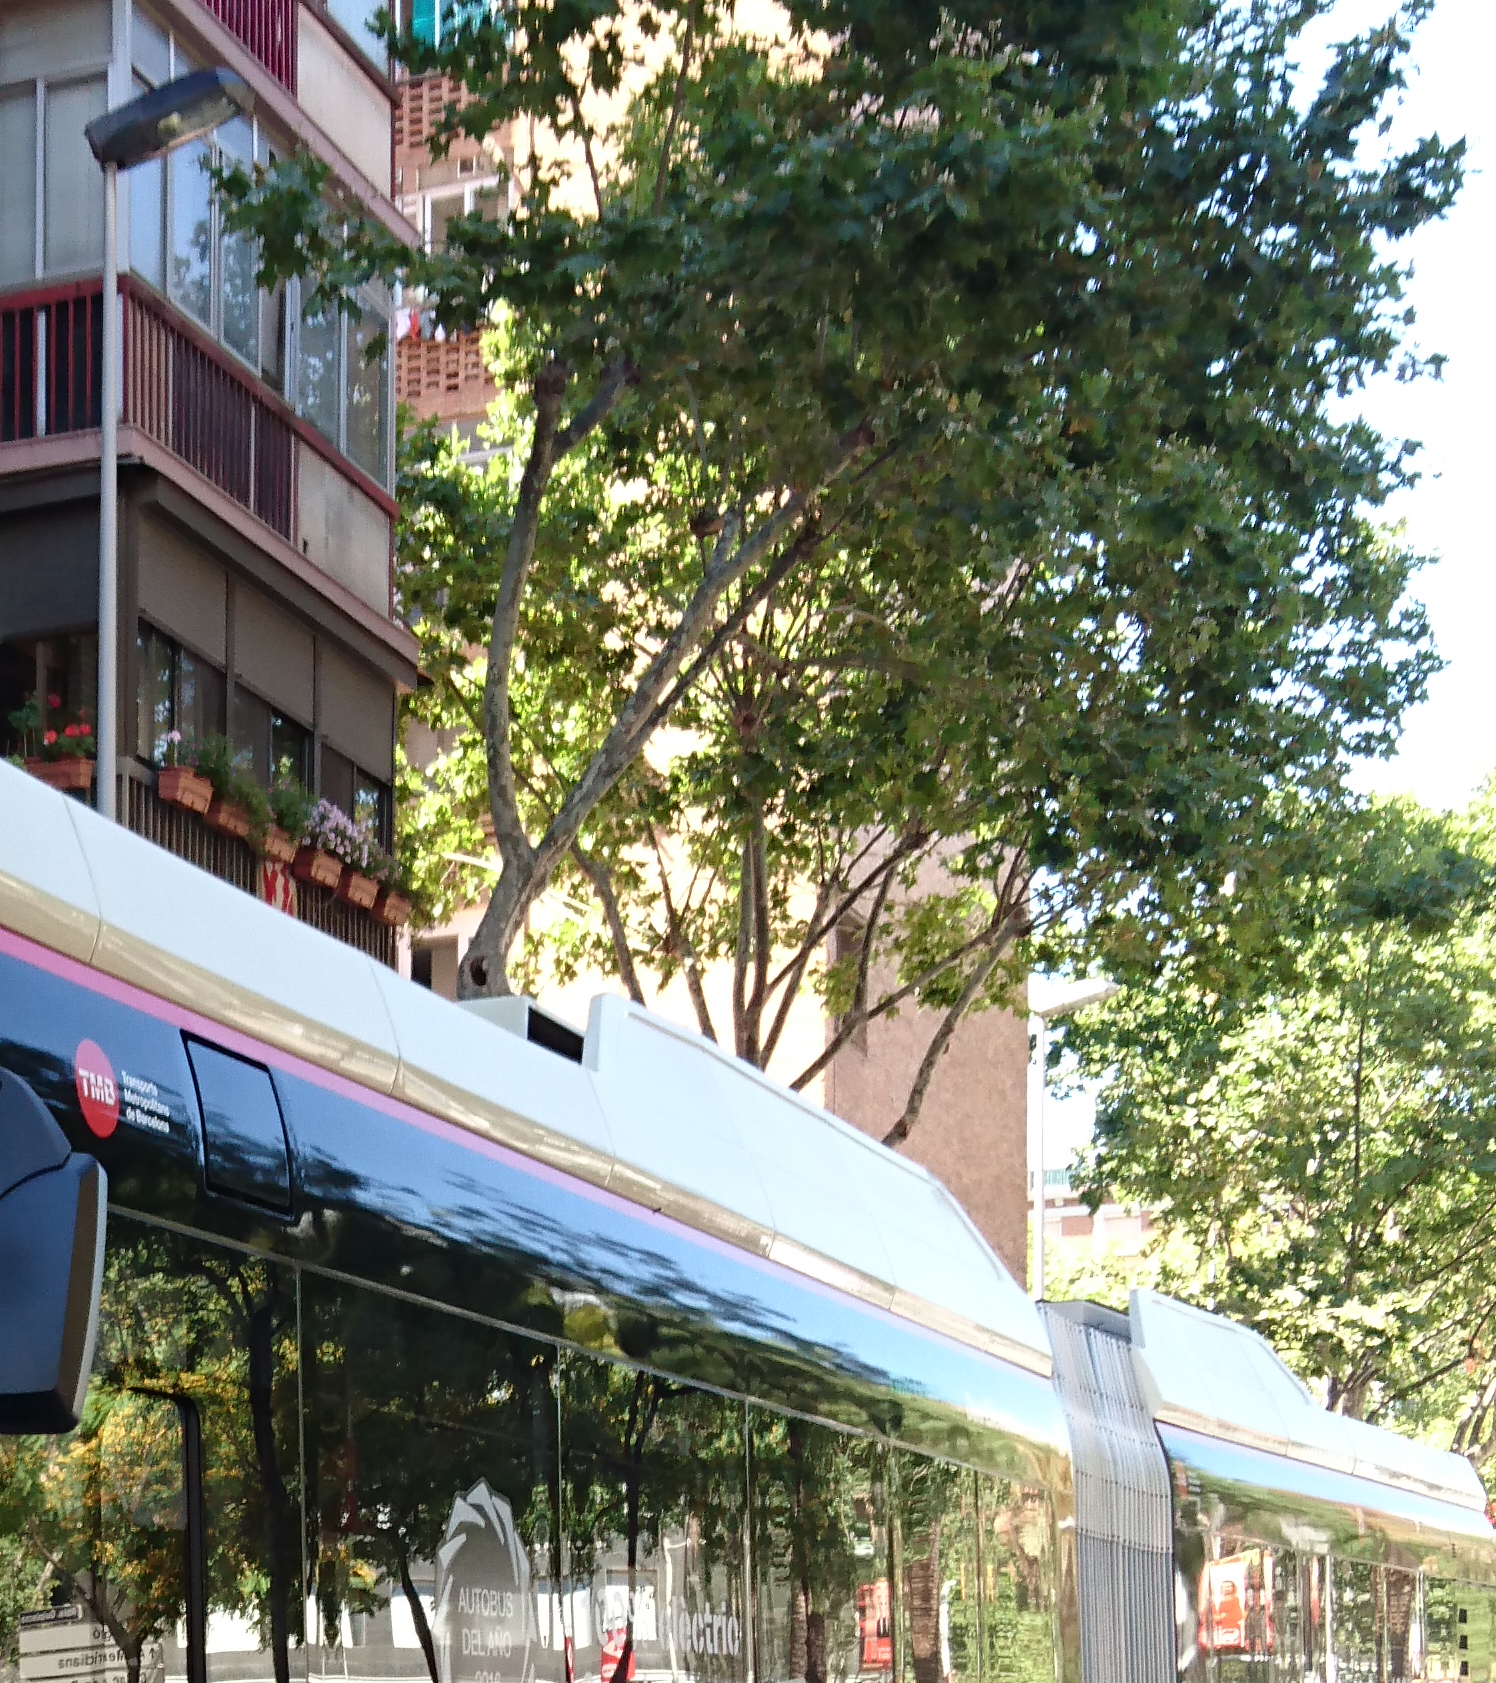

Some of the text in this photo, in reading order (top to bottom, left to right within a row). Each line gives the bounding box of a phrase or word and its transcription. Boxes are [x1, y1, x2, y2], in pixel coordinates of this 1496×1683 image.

[78, 1068, 115, 1106] TMB
[136, 1108, 170, 1134] Barcelona
[458, 1586, 513, 1618] AUTOBUS
[462, 1626, 512, 1658] DEL AÑO
